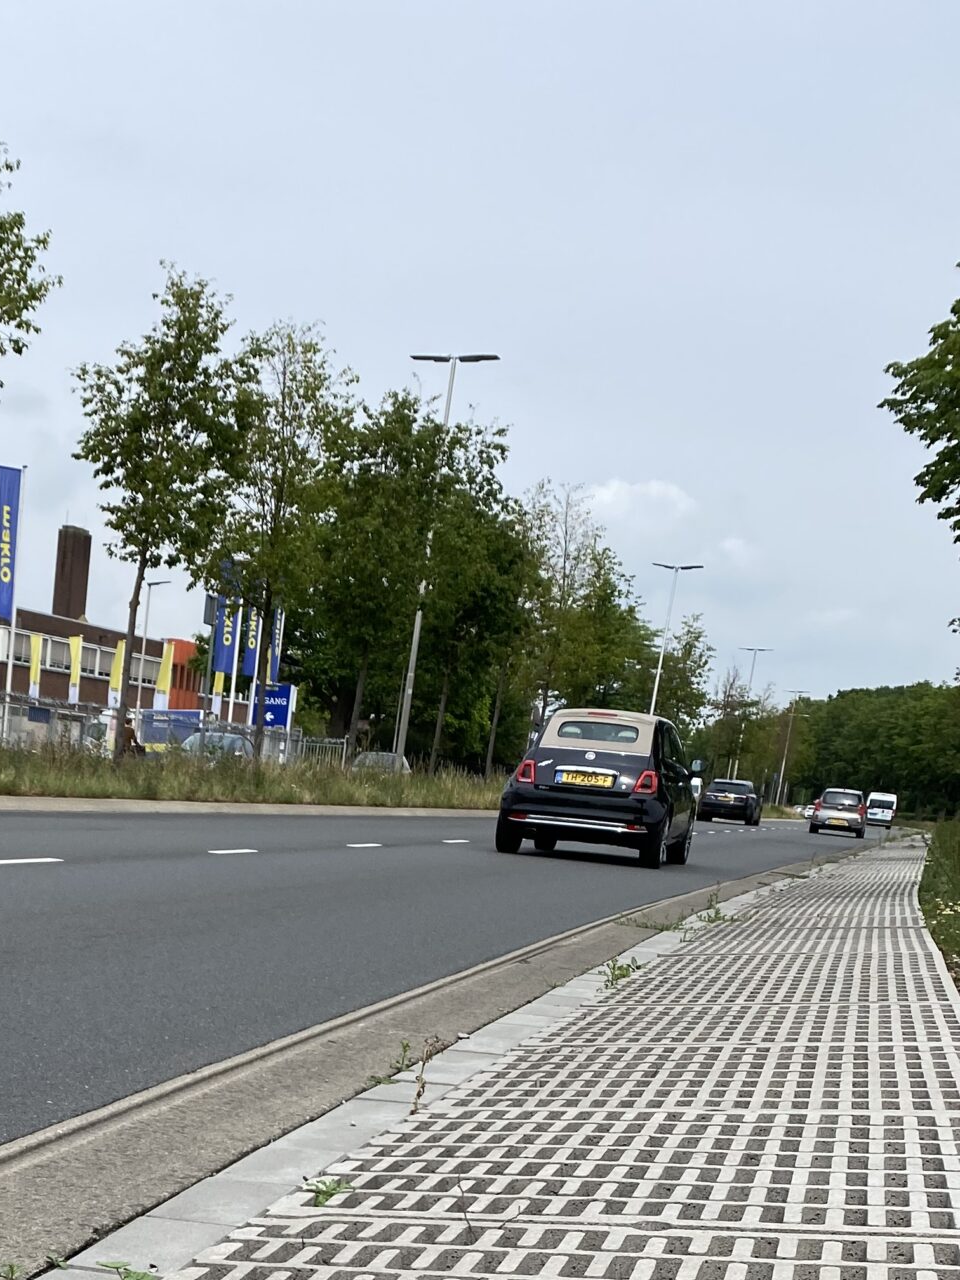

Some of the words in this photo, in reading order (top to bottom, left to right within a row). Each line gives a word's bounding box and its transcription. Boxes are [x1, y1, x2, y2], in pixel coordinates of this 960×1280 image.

[0, 505, 11, 583] makro
[254, 696, 287, 706] IGANG
[566, 773, 609, 784] TH-205-F
